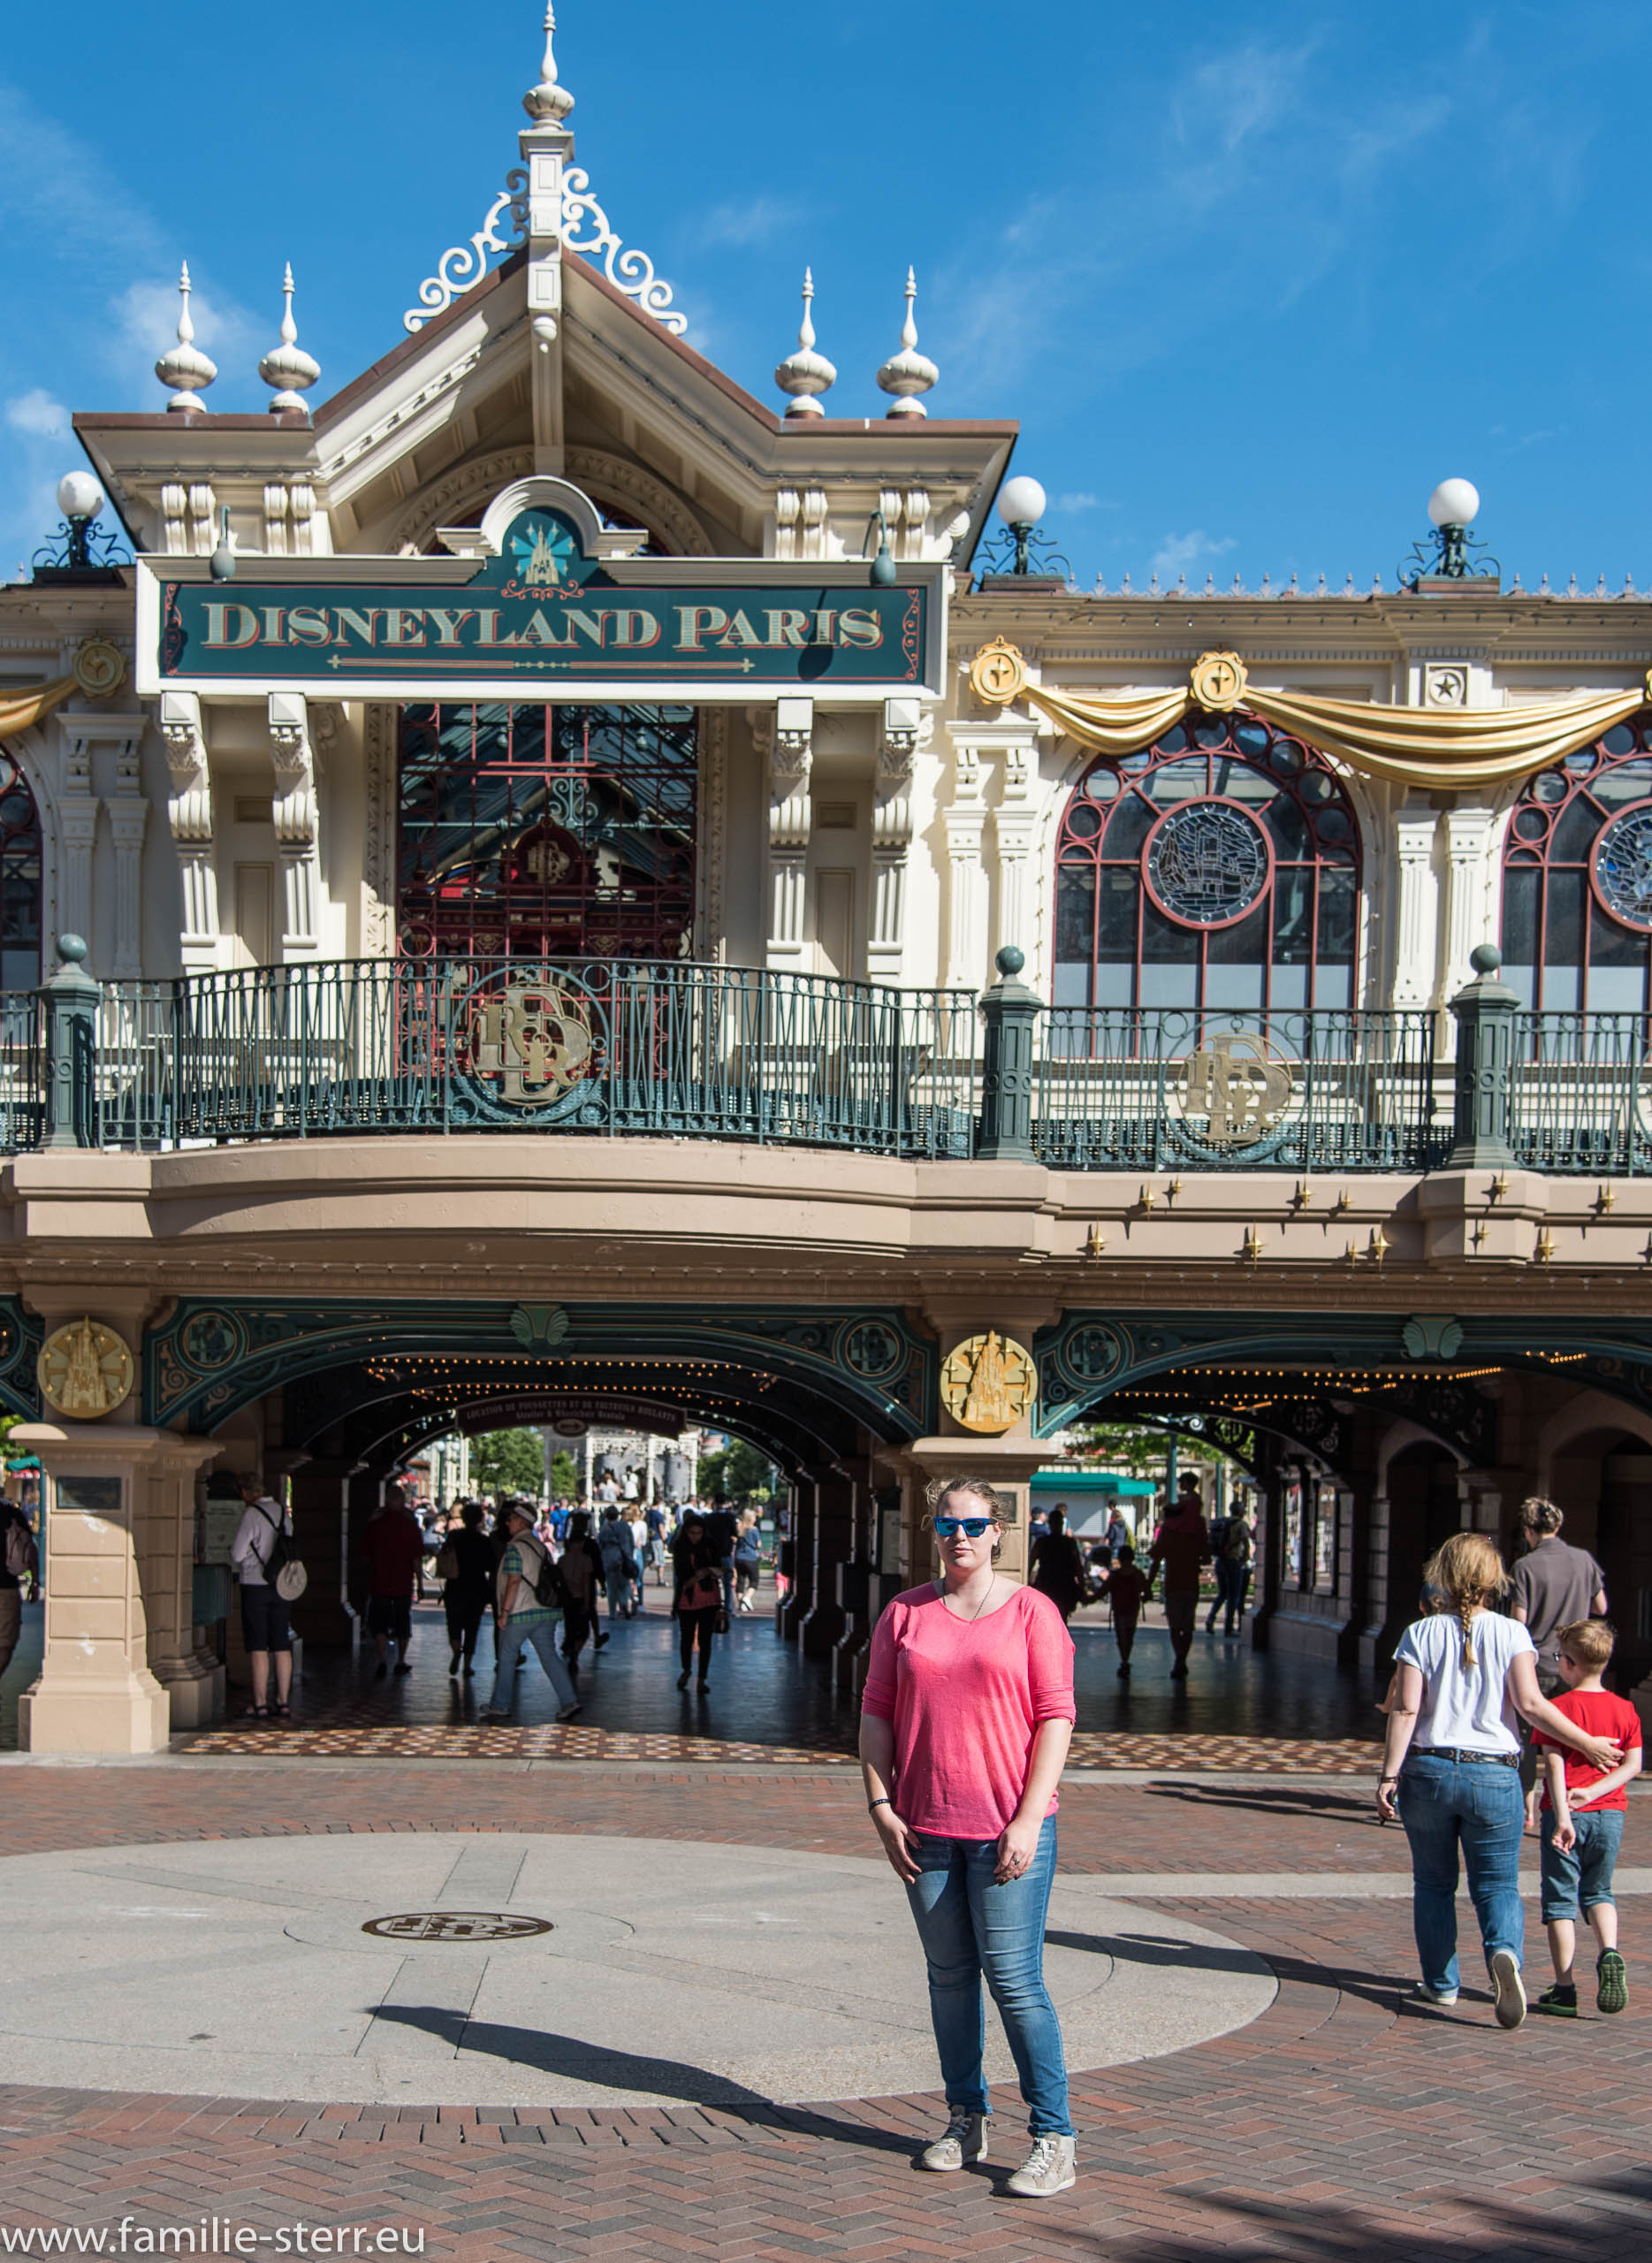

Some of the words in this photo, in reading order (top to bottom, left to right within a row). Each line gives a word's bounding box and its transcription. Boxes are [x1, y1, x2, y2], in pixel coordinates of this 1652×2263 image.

[200, 602, 661, 651] DISNEYLAND
[673, 606, 885, 652] PARIS
[467, 1404, 503, 1420] LOCATION
